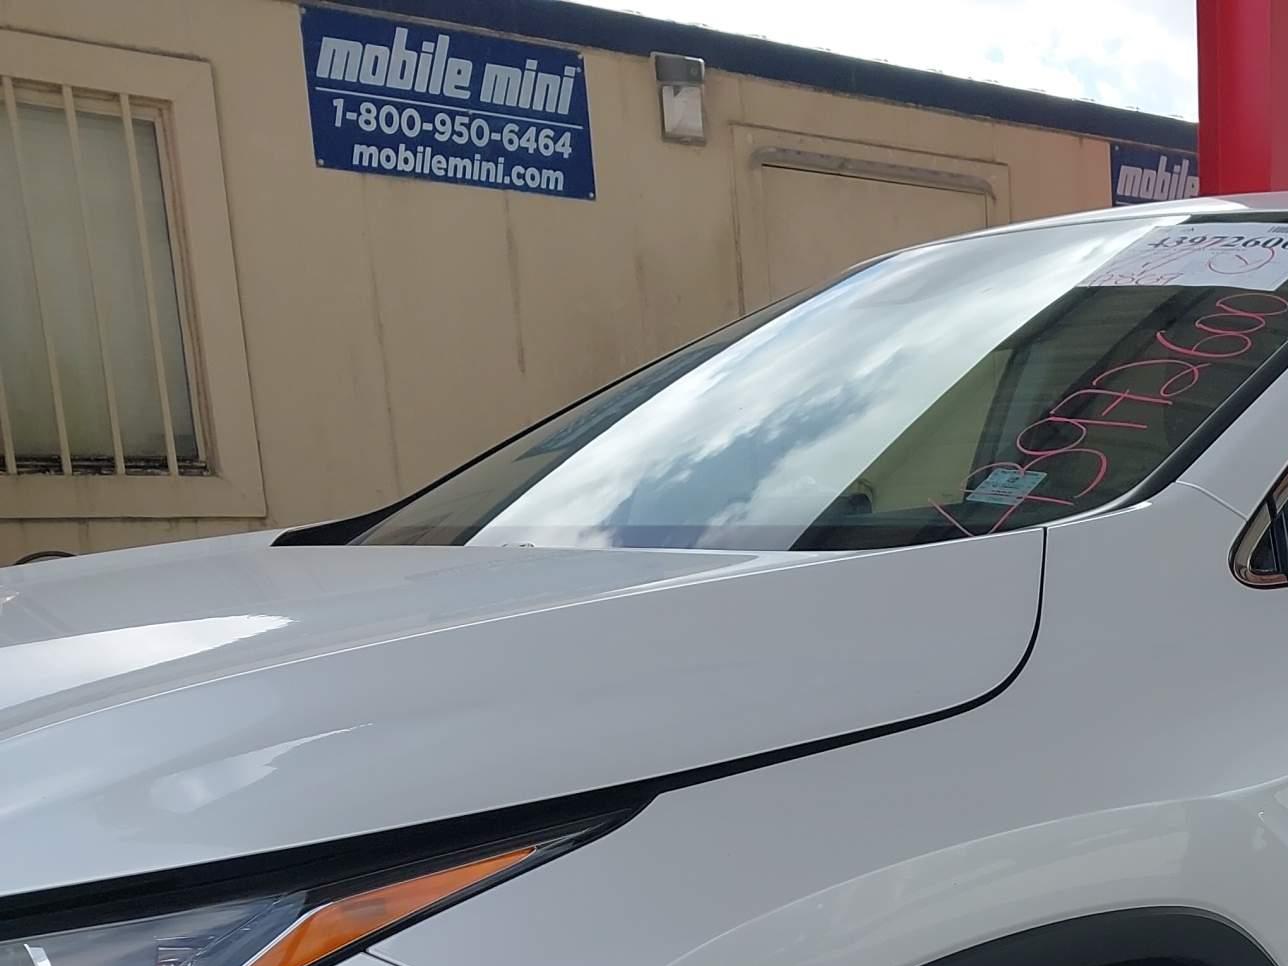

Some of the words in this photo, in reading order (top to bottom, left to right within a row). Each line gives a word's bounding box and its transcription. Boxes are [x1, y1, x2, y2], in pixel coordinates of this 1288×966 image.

[316, 26, 473, 99] mobile
[480, 59, 576, 115] mini
[332, 98, 572, 158] 1-800-950-6464
[352, 143, 564, 191] mobilemini.com
[1117, 155, 1200, 200] mobile
